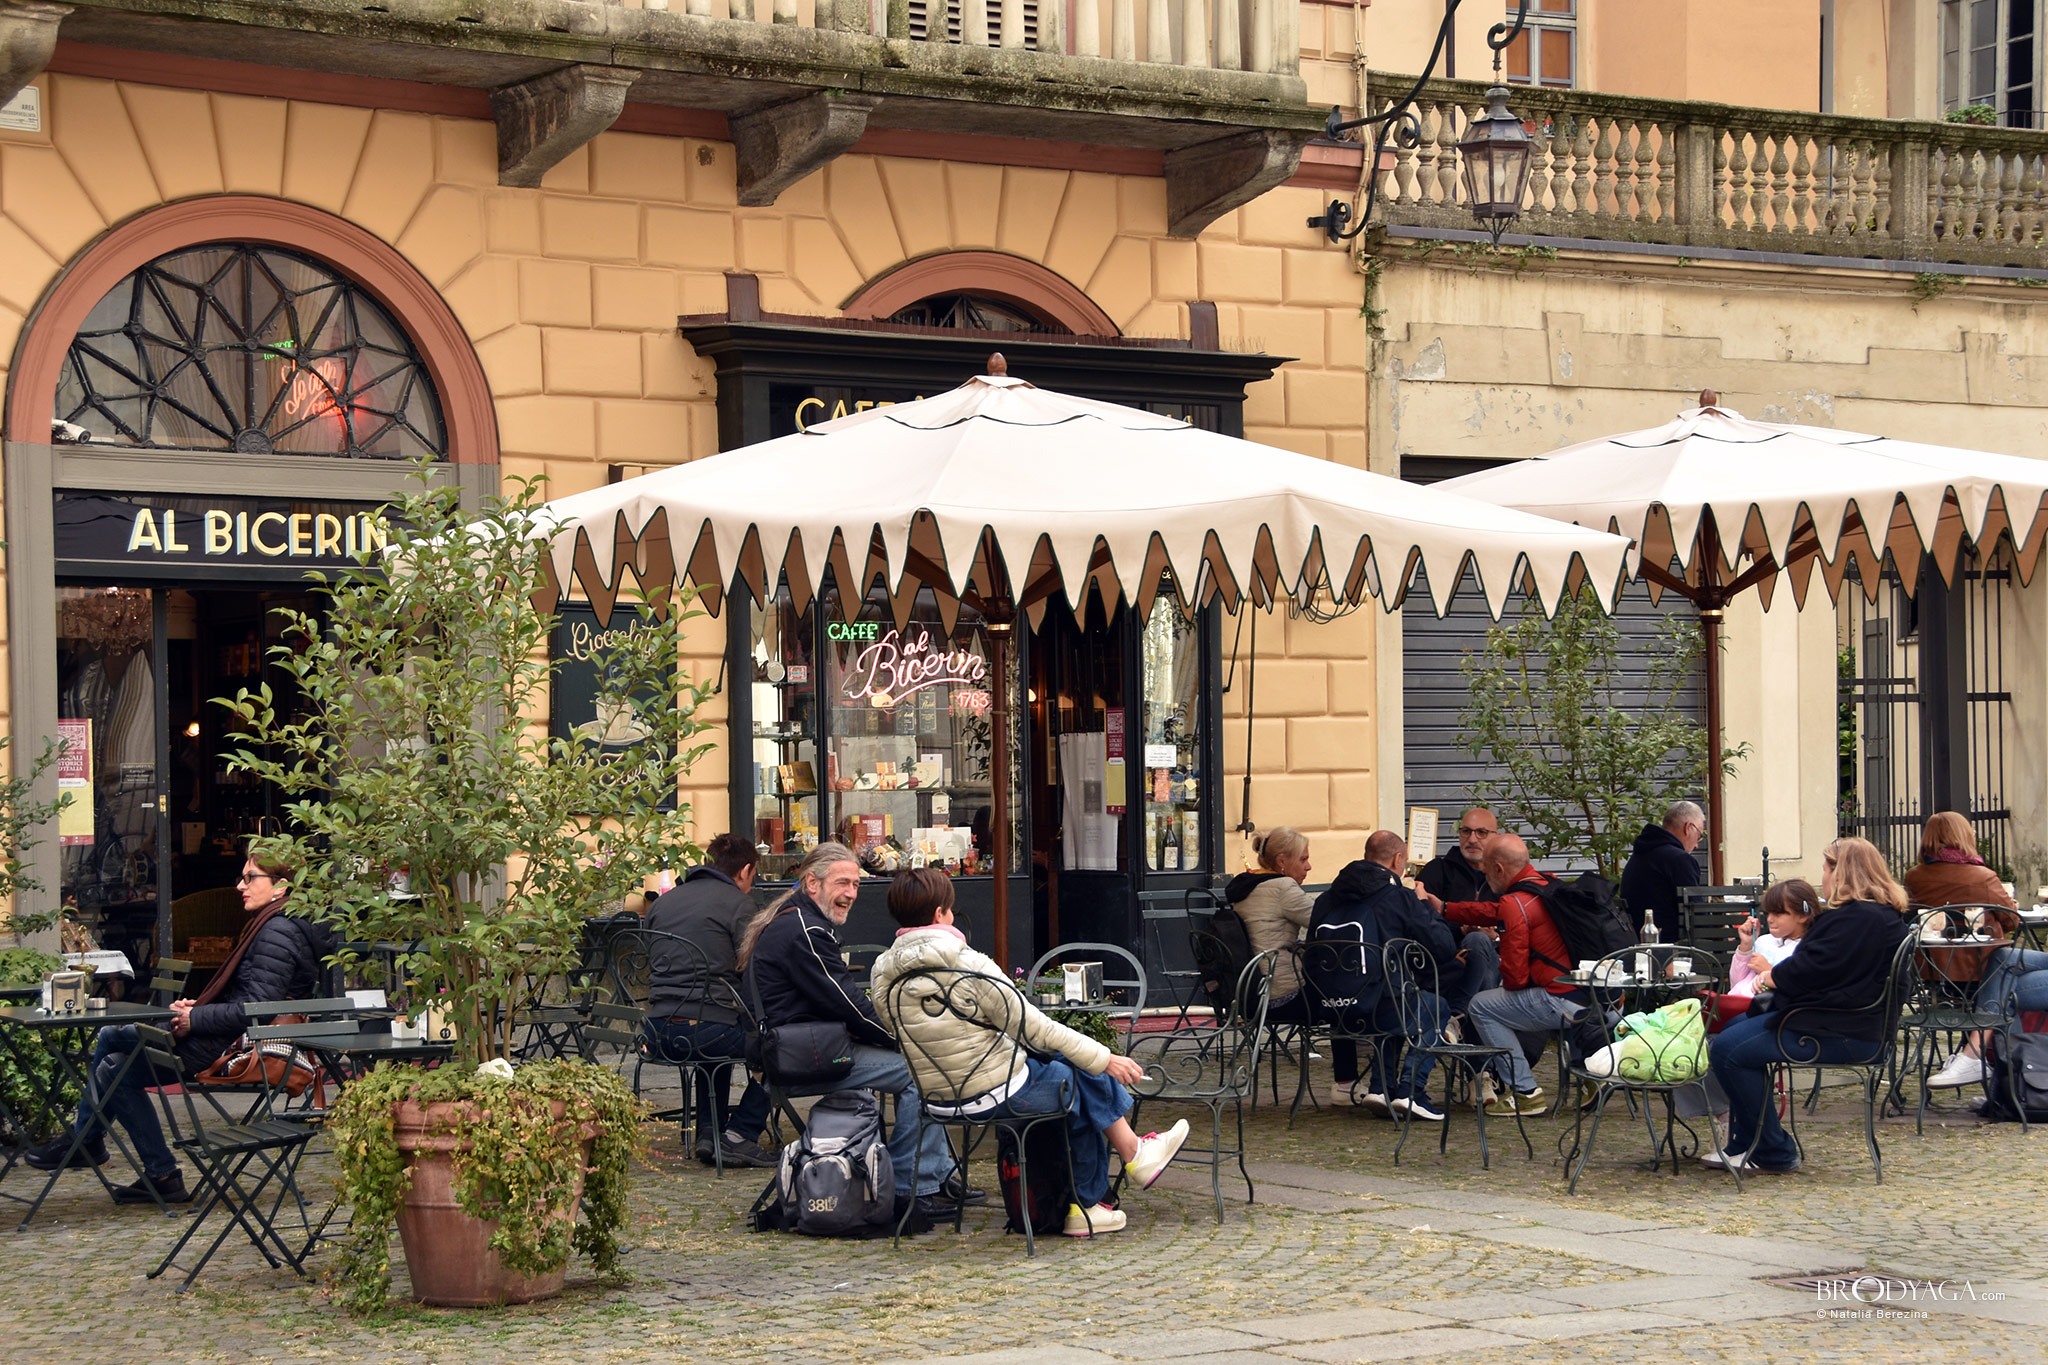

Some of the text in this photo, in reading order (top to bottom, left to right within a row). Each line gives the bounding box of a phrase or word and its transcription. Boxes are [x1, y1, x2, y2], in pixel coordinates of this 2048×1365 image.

[127, 508, 389, 559] AL BICERIN
[903, 630, 929, 656] al
[849, 629, 986, 699] Bicerin
[955, 691, 990, 709] 1763
[808, 1198, 834, 1212] 38L
